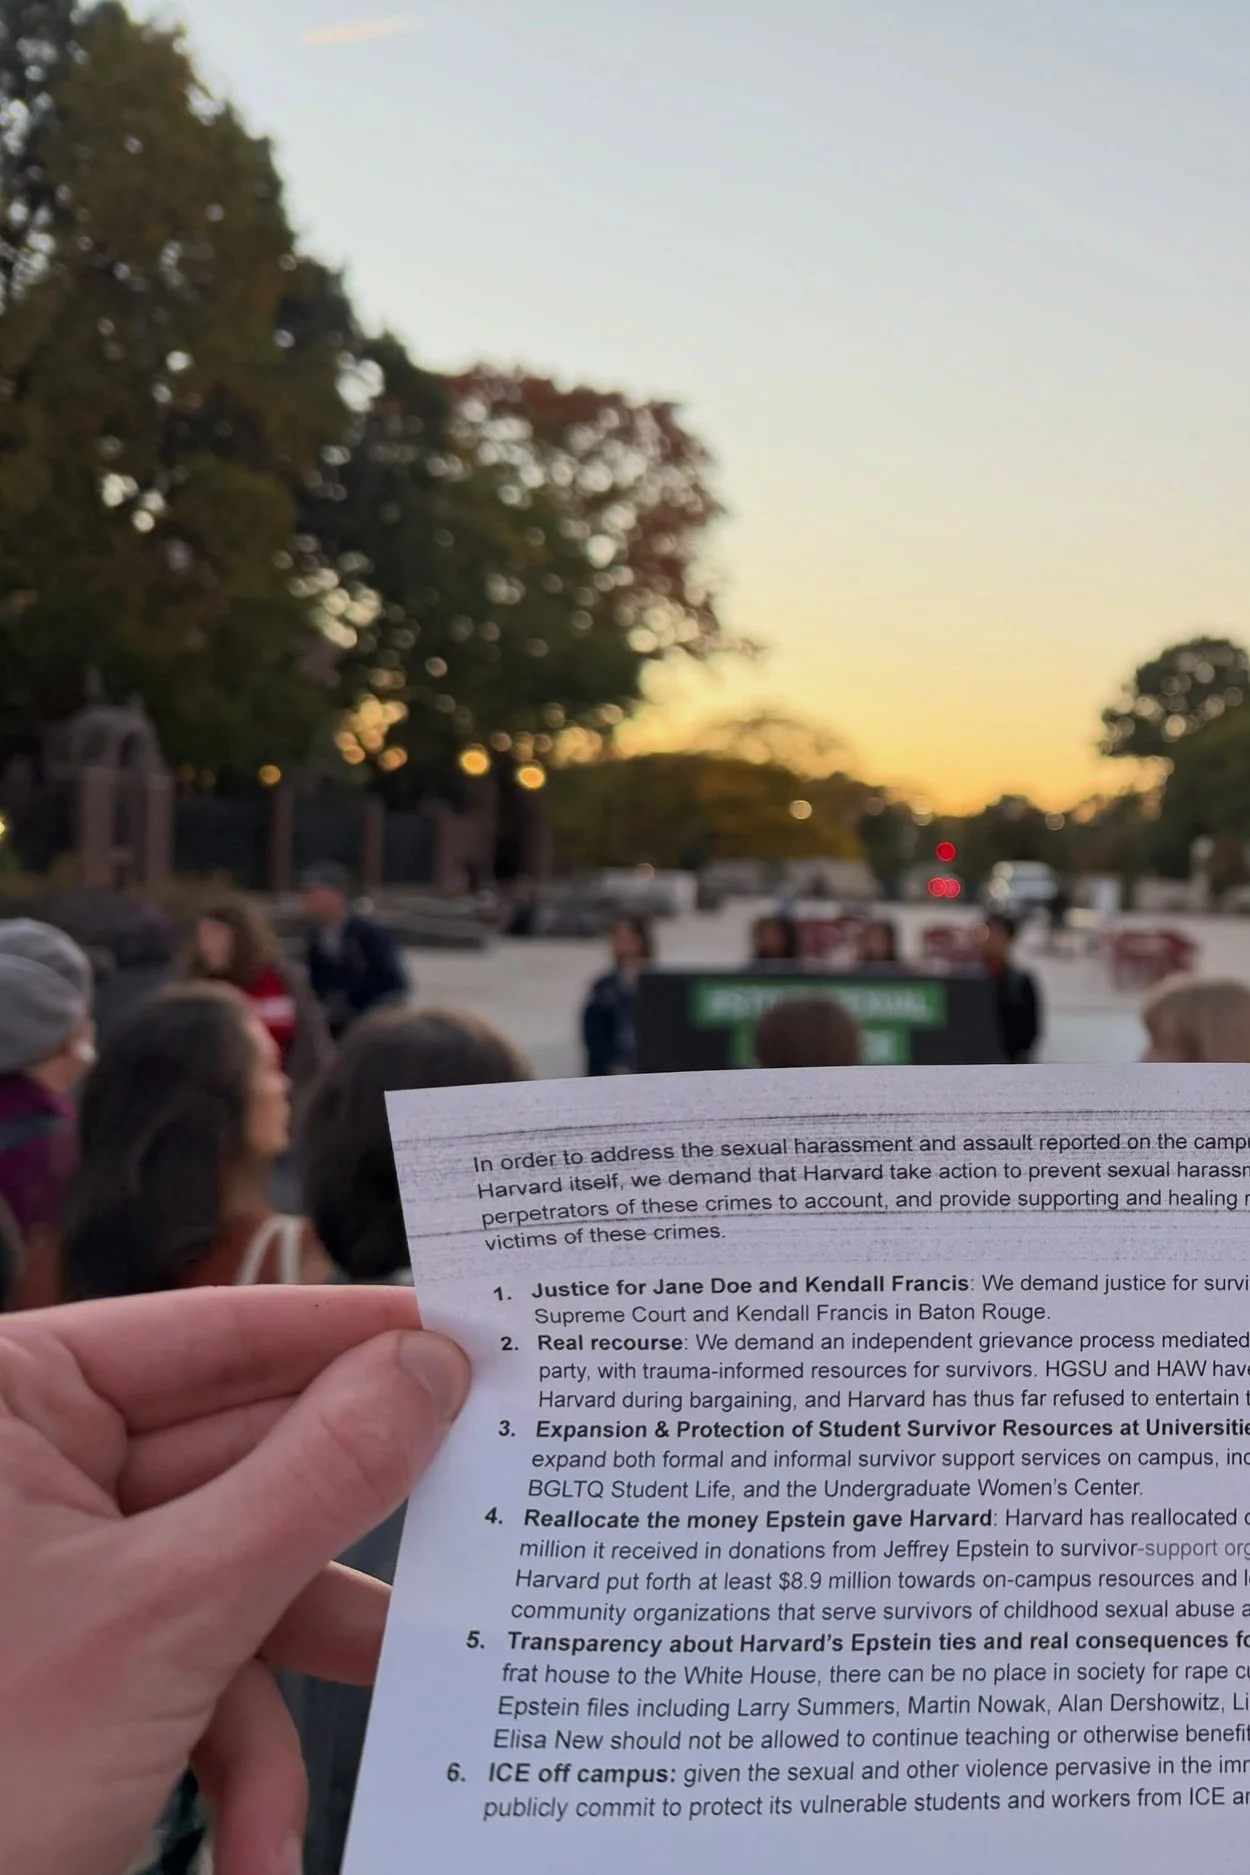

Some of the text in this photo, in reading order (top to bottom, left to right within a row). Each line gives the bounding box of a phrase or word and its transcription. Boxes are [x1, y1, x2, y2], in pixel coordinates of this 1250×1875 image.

[473, 1156, 493, 1172] In
[500, 1152, 556, 1169] order
[562, 1149, 583, 1165] to
[590, 1146, 674, 1162] address
[681, 1142, 714, 1157] the
[720, 1138, 787, 1156] sexual
[794, 1137, 913, 1153] harassment
[919, 1135, 956, 1151] and
[963, 1134, 1033, 1150] assault
[1039, 1133, 1124, 1153] reported
[1127, 1136, 1153, 1149] on
[1157, 1132, 1187, 1149] the
[484, 1224, 725, 1250] victims of these crimes.
[493, 1286, 512, 1301] 1.
[531, 1281, 609, 1297] Justice
[616, 1279, 647, 1295] for
[652, 1278, 704, 1294] Jane
[711, 1277, 752, 1293] Doe
[758, 1276, 797, 1293] and
[805, 1275, 884, 1292] Kendall
[892, 1274, 974, 1291] Francis:
[982, 1273, 1014, 1290] We
[1020, 1274, 1098, 1290] demand
[1105, 1274, 1166, 1293] justice
[1172, 1273, 1198, 1290] for
[500, 1335, 519, 1350] 2.
[537, 1334, 583, 1350] Real
[590, 1337, 687, 1350] recourse:
[695, 1333, 728, 1350] We
[734, 1333, 814, 1350] demand
[820, 1336, 844, 1349] an
[852, 1332, 972, 1351] independent
[978, 1332, 1073, 1352] grievance
[1080, 1334, 1155, 1351] process
[1162, 1331, 1249, 1348] mediated
[498, 1419, 515, 1436] 3.
[536, 1420, 647, 1440] Expansion
[654, 1420, 669, 1438] &
[677, 1420, 784, 1437] Protection
[791, 1419, 813, 1437] of
[818, 1419, 901, 1437] Student
[907, 1419, 996, 1436] Survivor
[1002, 1419, 1113, 1436] Resources
[1119, 1419, 1139, 1435] at
[528, 1478, 604, 1497] BGLTQ
[611, 1480, 688, 1498] Student
[695, 1479, 735, 1499] Life,
[743, 1480, 780, 1497] and
[786, 1480, 817, 1497] the
[824, 1479, 970, 1500] Undergraduate
[1074, 1477, 1143, 1495] Center.
[484, 1506, 503, 1524] 4.
[524, 1509, 640, 1528] Reallocate
[647, 1510, 680, 1528] the
[687, 1514, 759, 1532] money
[766, 1510, 845, 1531] Epstein
[852, 1513, 902, 1531] gave
[910, 1508, 997, 1526] Harvard:
[1005, 1508, 1082, 1525] Harvard
[1090, 1508, 1124, 1525] has
[1131, 1508, 1237, 1525] reallocated
[511, 1603, 626, 1624] community
[633, 1603, 770, 1624] organizations
[777, 1602, 815, 1620] that
[821, 1605, 876, 1620] serve
[883, 1601, 972, 1619] survivors
[979, 1599, 998, 1618] of
[1003, 1600, 1098, 1618] childhood
[1105, 1600, 1168, 1617] sexual
[1175, 1599, 1235, 1617] abuse
[466, 1629, 485, 1648] 5.
[508, 1630, 662, 1658] Transparency
[669, 1635, 733, 1652] about
[851, 1632, 931, 1654] Epstein
[938, 1632, 976, 1650] ties
[983, 1631, 1022, 1649] and
[1030, 1631, 1068, 1649] real
[1075, 1634, 1228, 1651] consequences
[498, 1696, 579, 1718] Epstein
[587, 1697, 629, 1716] files
[636, 1698, 730, 1719] including
[738, 1697, 790, 1721] Larry
[797, 1697, 899, 1718] Summers,
[908, 1695, 970, 1713] Martin
[978, 1694, 1050, 1714] Nowak,
[1057, 1693, 1102, 1712] Alan
[1110, 1692, 1224, 1711] Dershowitz,
[446, 1762, 466, 1781] 6.
[488, 1762, 529, 1782] ICE
[538, 1762, 571, 1782] off
[577, 1767, 676, 1784] campus:
[683, 1763, 740, 1784] given
[747, 1762, 780, 1781] the
[787, 1761, 854, 1780] sexual
[861, 1760, 899, 1779] and
[906, 1760, 959, 1778] other
[965, 1758, 1048, 1777] violence
[1055, 1757, 1151, 1779] pervasive
[1158, 1755, 1174, 1774] in
[1181, 1755, 1212, 1773] the
